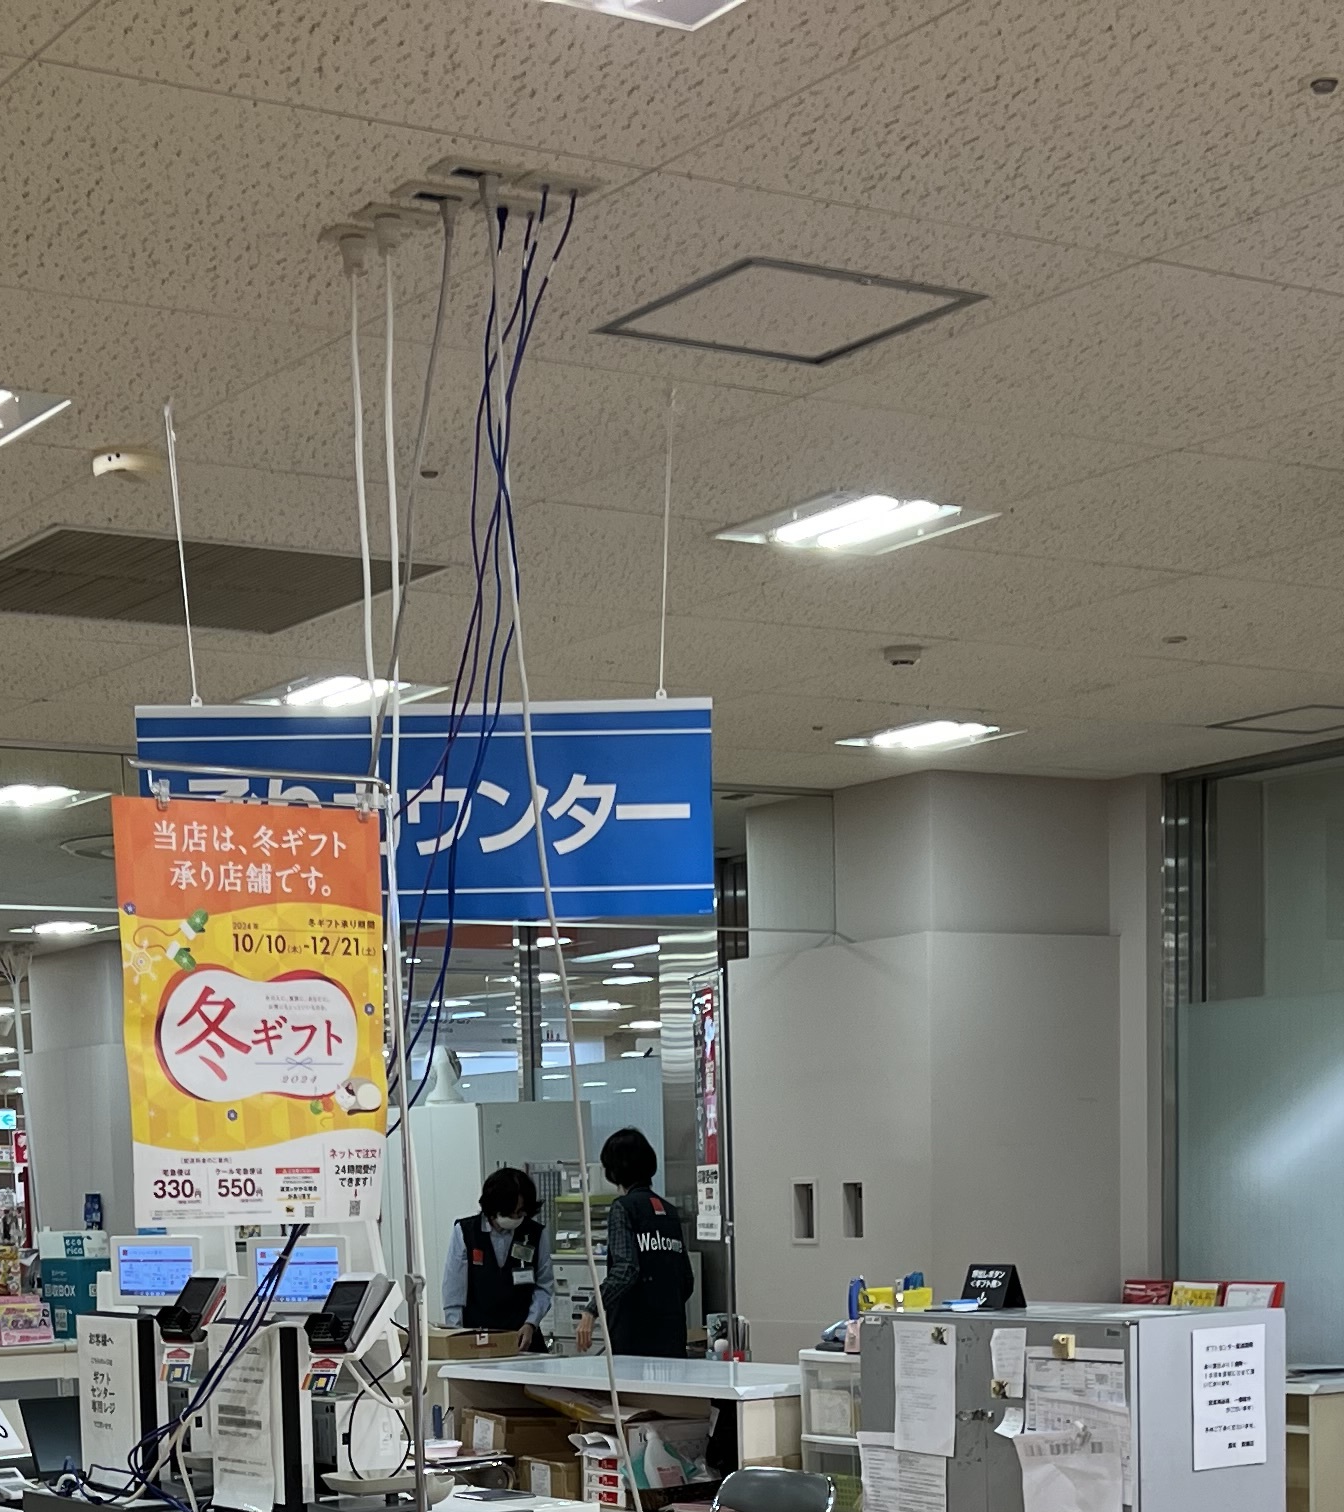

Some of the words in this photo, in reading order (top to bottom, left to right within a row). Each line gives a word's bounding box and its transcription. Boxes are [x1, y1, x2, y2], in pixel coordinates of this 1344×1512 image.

[152, 820, 348, 860] 当店は、冬ギフト
[170, 861, 332, 898] 承り店舗です。
[175, 986, 343, 1082] 冬ギフト
[88, 1332, 115, 1348] お客様へ
[92, 1371, 112, 1385] ギフト
[90, 1385, 116, 1399] センター
